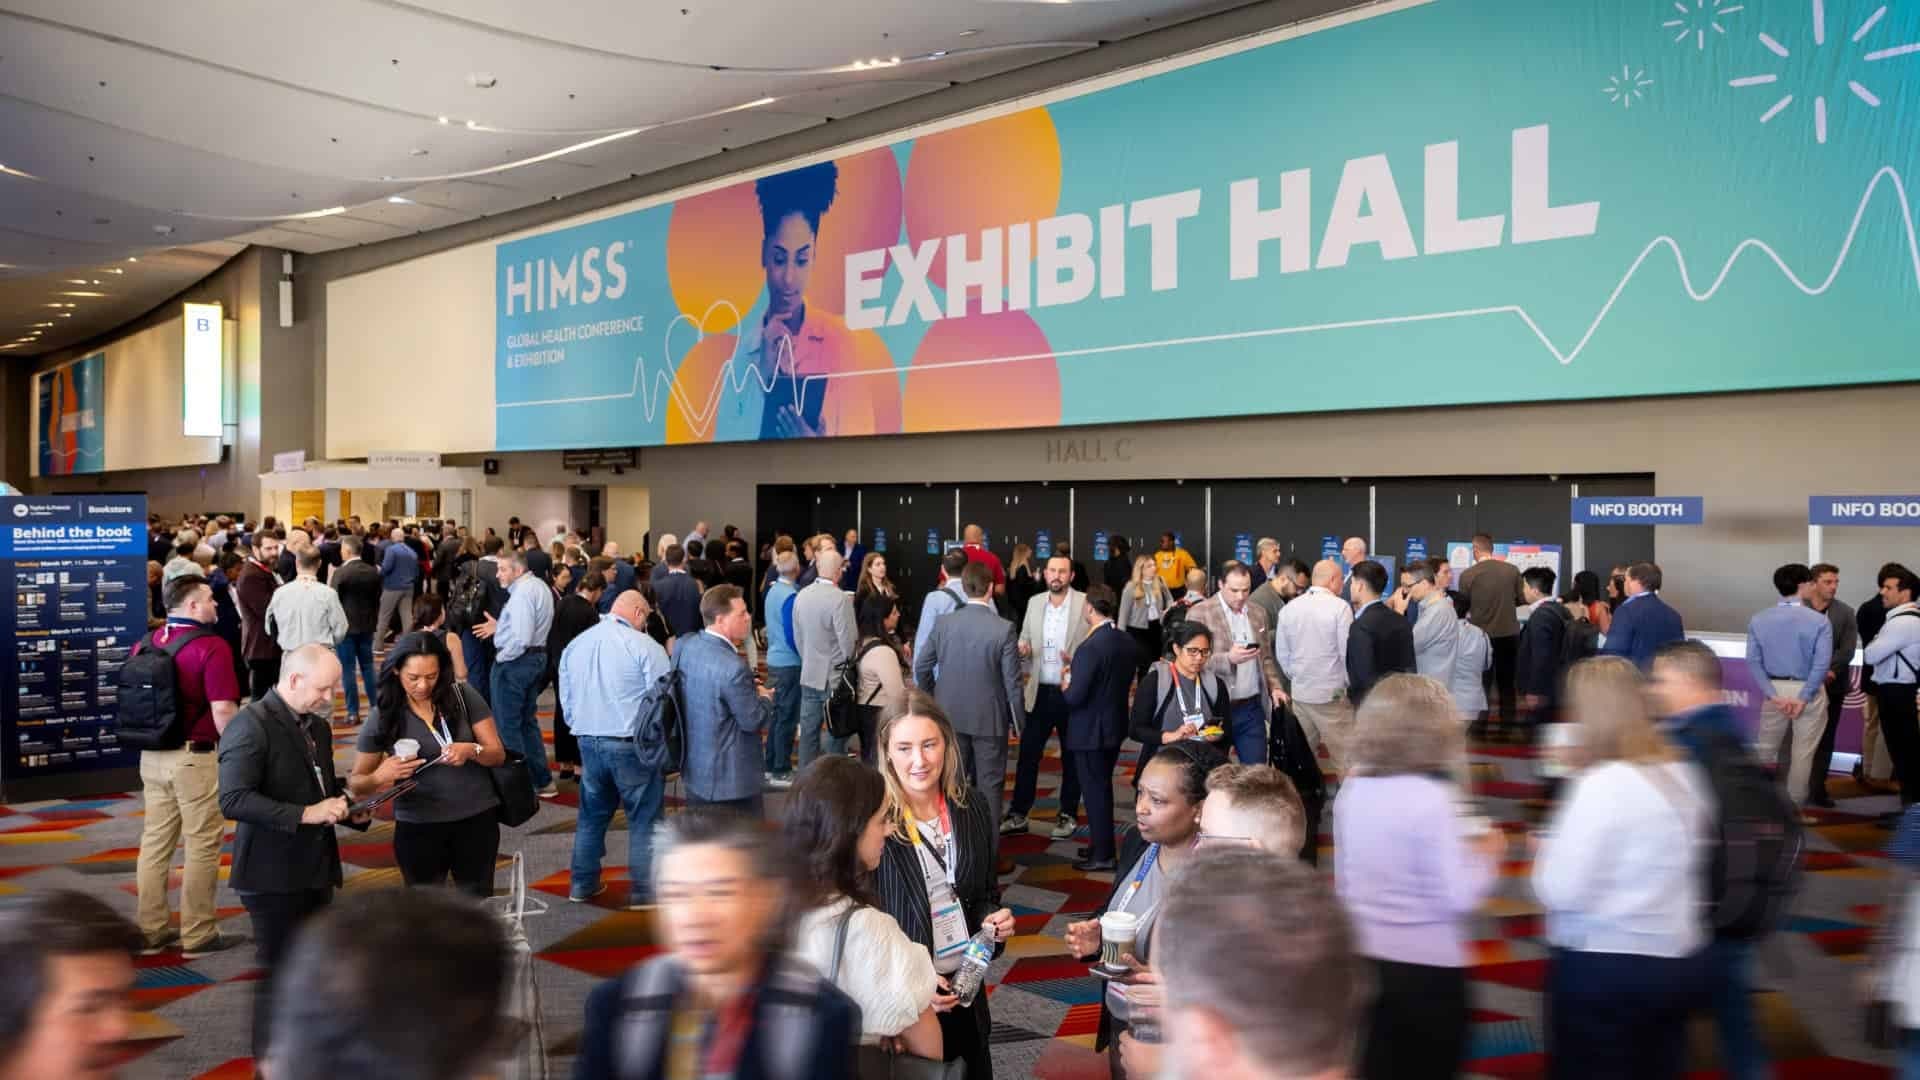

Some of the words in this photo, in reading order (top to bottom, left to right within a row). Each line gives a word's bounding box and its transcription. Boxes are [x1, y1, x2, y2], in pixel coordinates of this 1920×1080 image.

[843, 189, 1201, 331] EXHIBIT
[1229, 124, 1600, 281] HALL
[506, 241, 628, 316] HIMSS
[197, 318, 210, 332] B
[506, 332, 540, 349] GLOBAL
[541, 328, 576, 344] HEALTH
[577, 315, 644, 339] CONFERENCE
[514, 348, 566, 368] EXHIBITION
[1046, 439, 1108, 465] HALL
[1115, 438, 1133, 463] C
[88, 505, 133, 514] Bookstore
[1590, 503, 1625, 517] INFO
[1628, 503, 1683, 517] BOOTH
[1831, 502, 1875, 517] INFO
[1879, 502, 1920, 518] BOO
[13, 526, 65, 539] Behind
[68, 525, 94, 538] the
[96, 525, 133, 538] book
